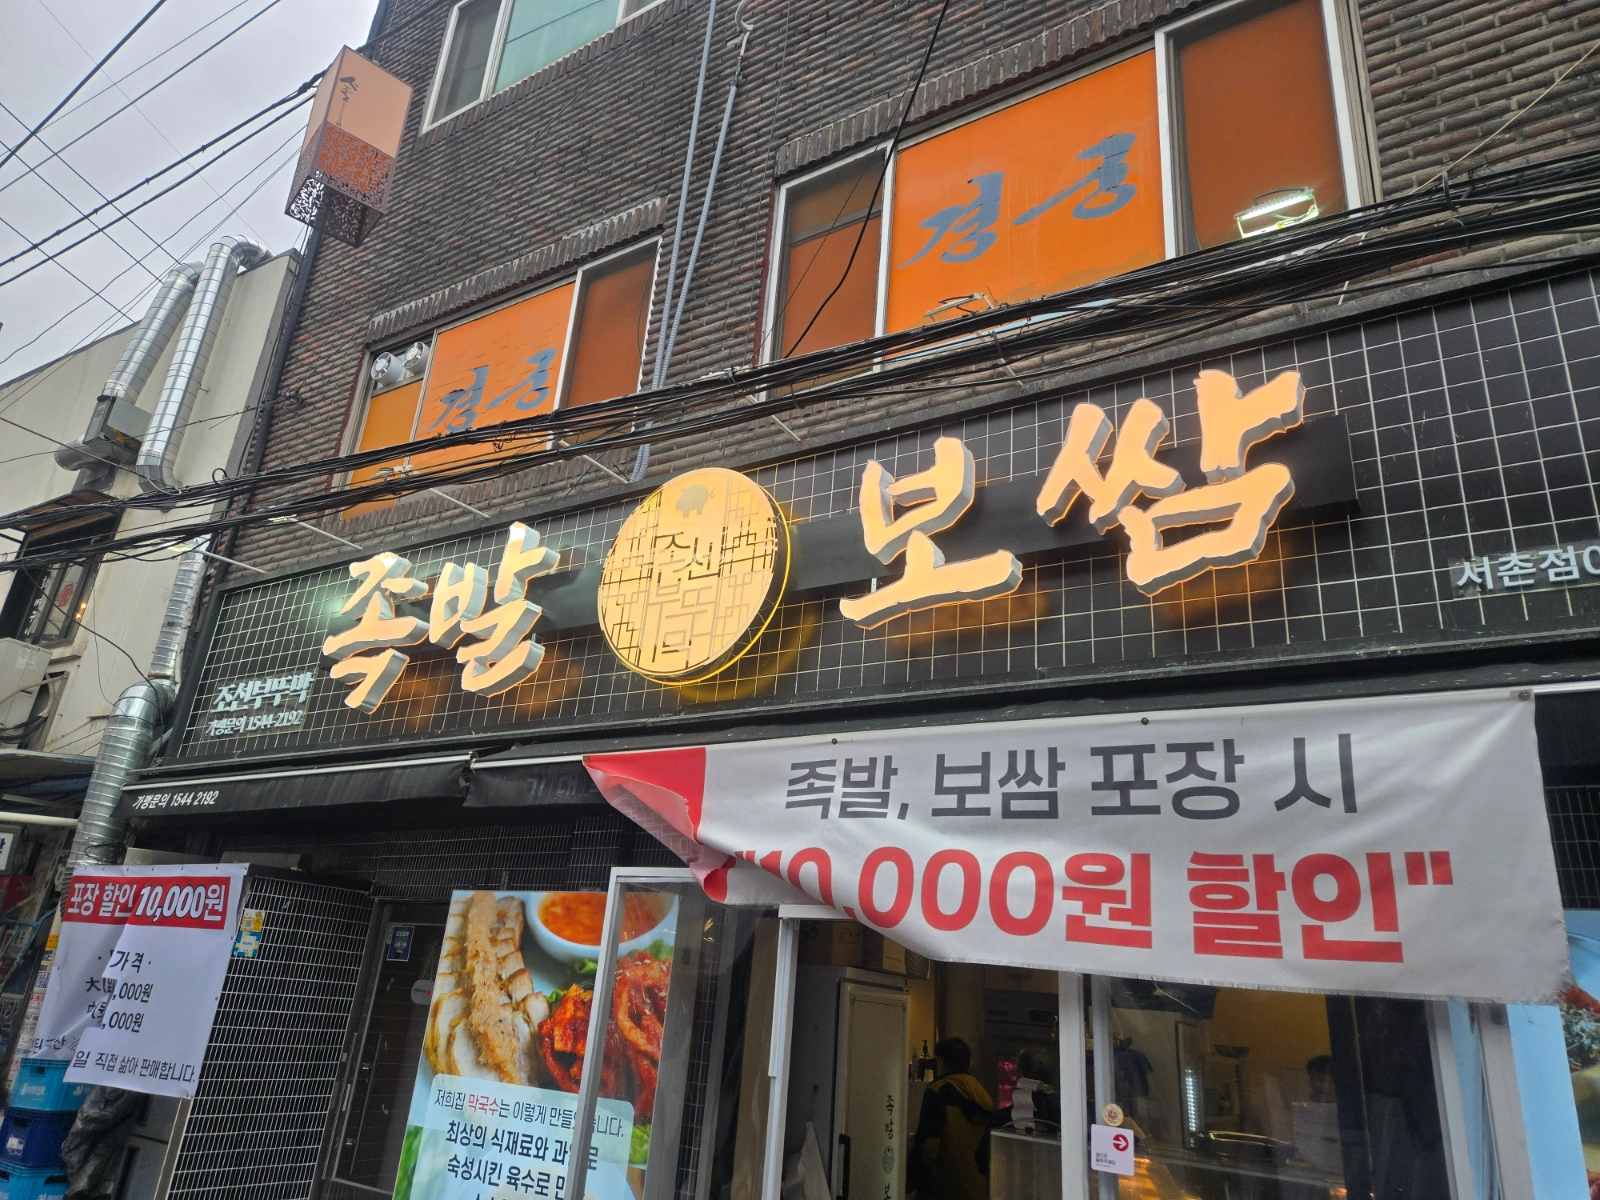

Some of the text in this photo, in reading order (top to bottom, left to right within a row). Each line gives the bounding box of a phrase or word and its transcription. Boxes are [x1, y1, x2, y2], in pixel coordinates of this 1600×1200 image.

[839, 369, 1306, 629] 보쌈
[322, 521, 560, 714] 족발
[211, 671, 314, 713] 조선부뚜막
[205, 710, 303, 737] 가맹문의 1544-2192
[784, 733, 1360, 821] 족발, 보쌈 포장 시
[132, 790, 219, 810] 가맹문의 1544 2192
[67, 882, 226, 922] 포장 할인 10,000원
[95, 1052, 119, 1072] 직접
[118, 1055, 139, 1076] 삶아
[139, 1058, 196, 1083] 판매합니다.
[434, 1088, 467, 1111] 저희집
[467, 1093, 511, 1119] 막국수는
[512, 1100, 548, 1125] 이렇게
[446, 1119, 488, 1150] 최상의
[490, 1127, 549, 1162] 식재료와
[447, 1153, 503, 1187] 숙성시킨
[506, 1165, 551, 1197] 육수로
